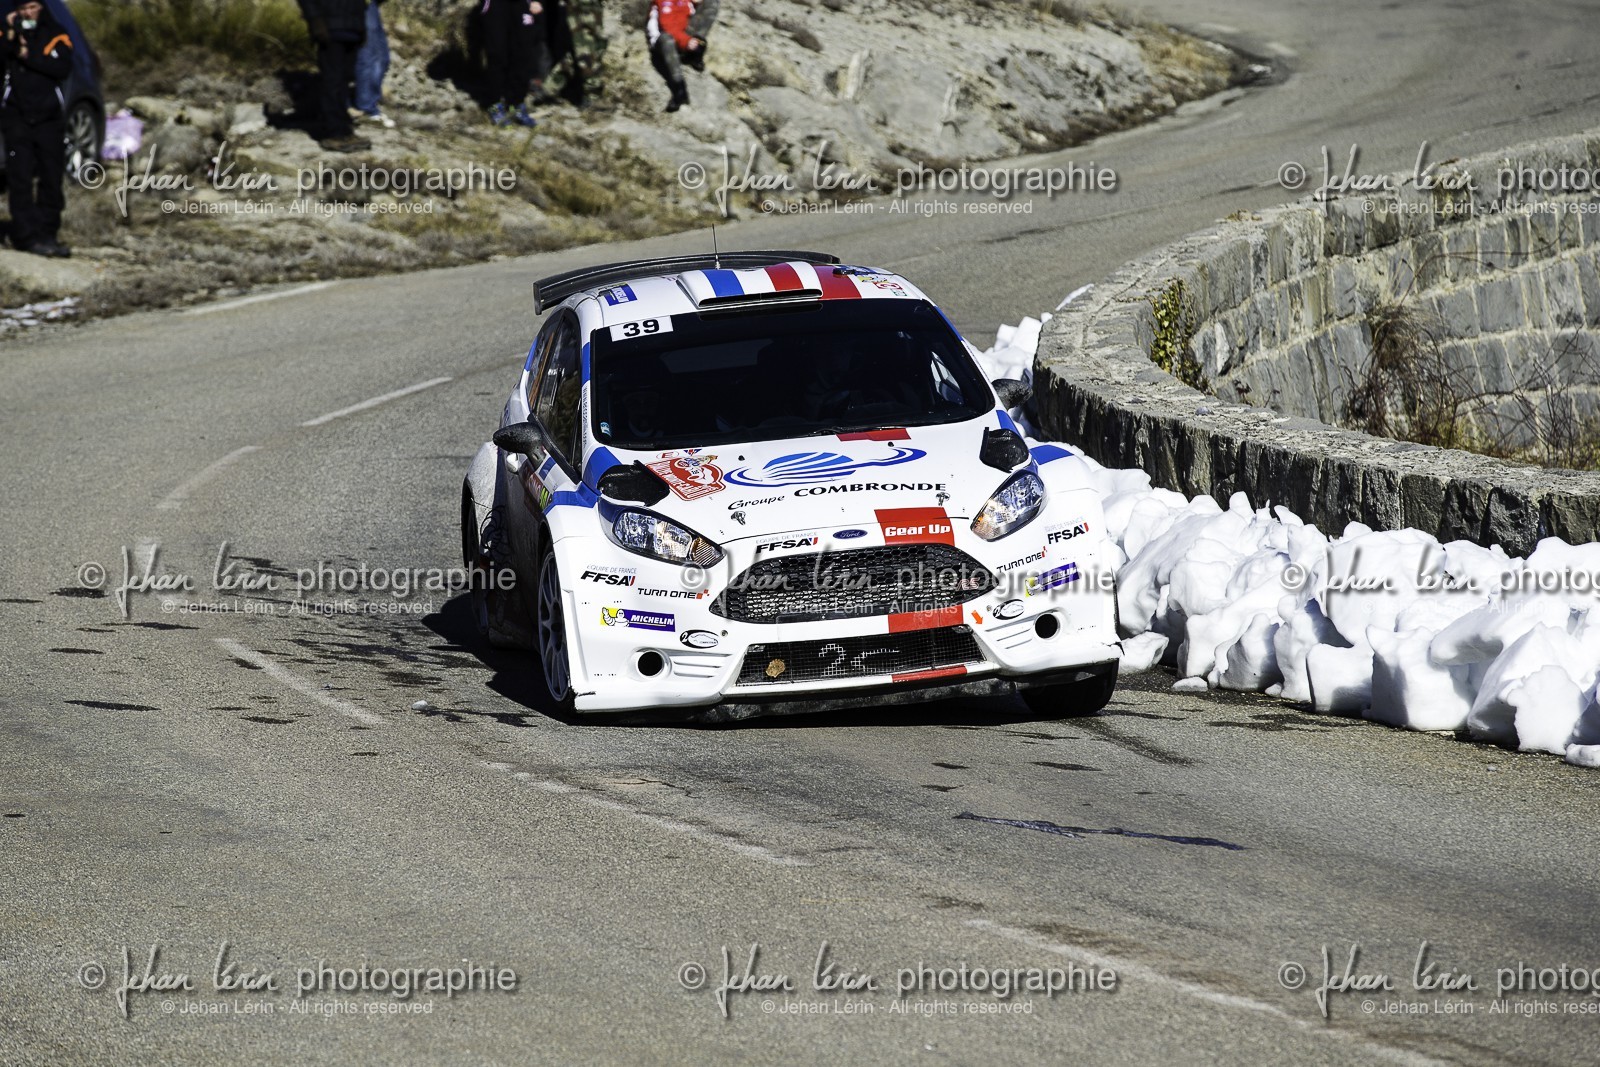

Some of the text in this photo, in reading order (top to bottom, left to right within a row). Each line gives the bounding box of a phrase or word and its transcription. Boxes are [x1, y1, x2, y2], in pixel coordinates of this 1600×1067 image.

[622, 319, 660, 337] 39
[727, 482, 946, 511] Groupe COMBRONDE
[885, 524, 951, 537] Gear Up
[1047, 525, 1086, 544] FFSA
[755, 538, 812, 553] FFSA
[580, 570, 630, 586] FFSA
[630, 614, 675, 626] MICHELIN
